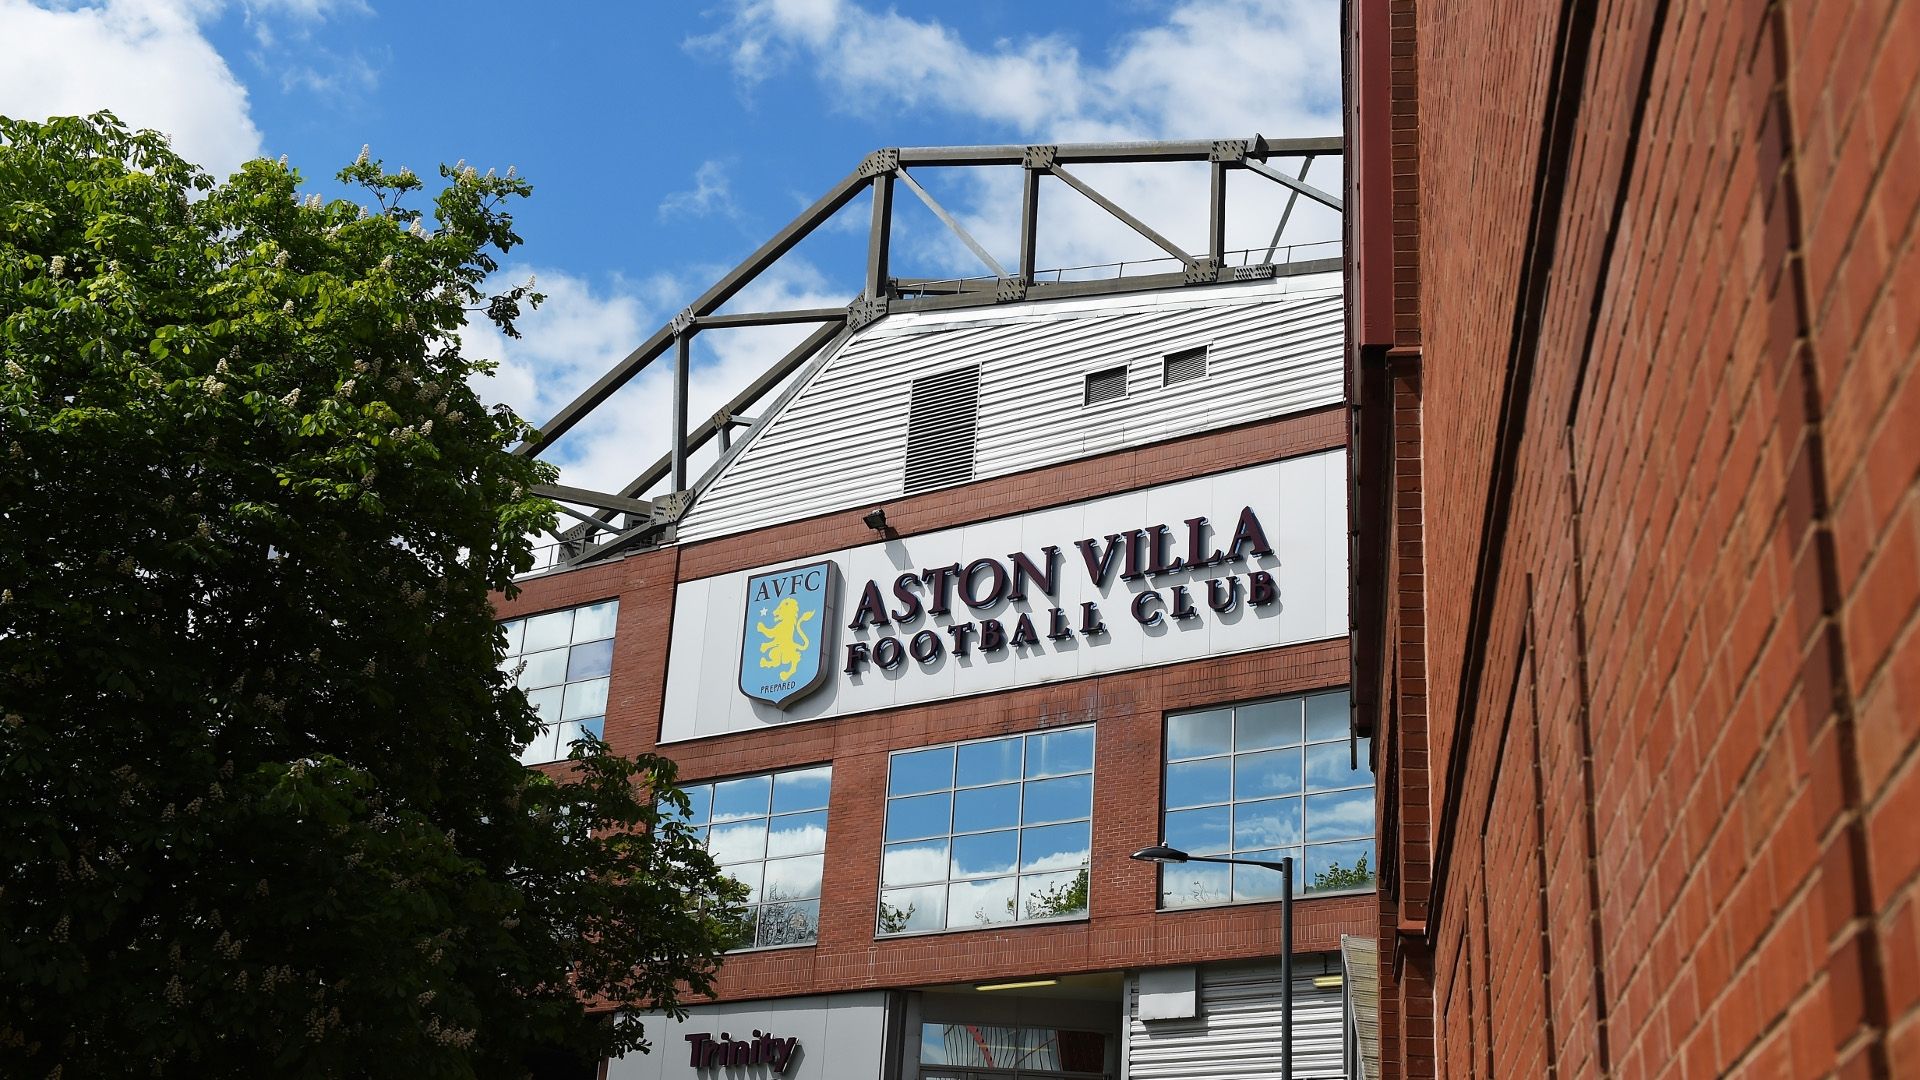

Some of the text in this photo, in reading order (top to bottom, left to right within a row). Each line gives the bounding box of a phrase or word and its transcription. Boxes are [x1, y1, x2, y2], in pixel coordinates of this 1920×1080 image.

[754, 570, 821, 602] AVFC
[848, 505, 1275, 631] ASTON VILLA
[843, 570, 1275, 675] FOOTBALL CLUB
[760, 680, 796, 694] PREPARED
[684, 1028, 799, 1074] Trinity
